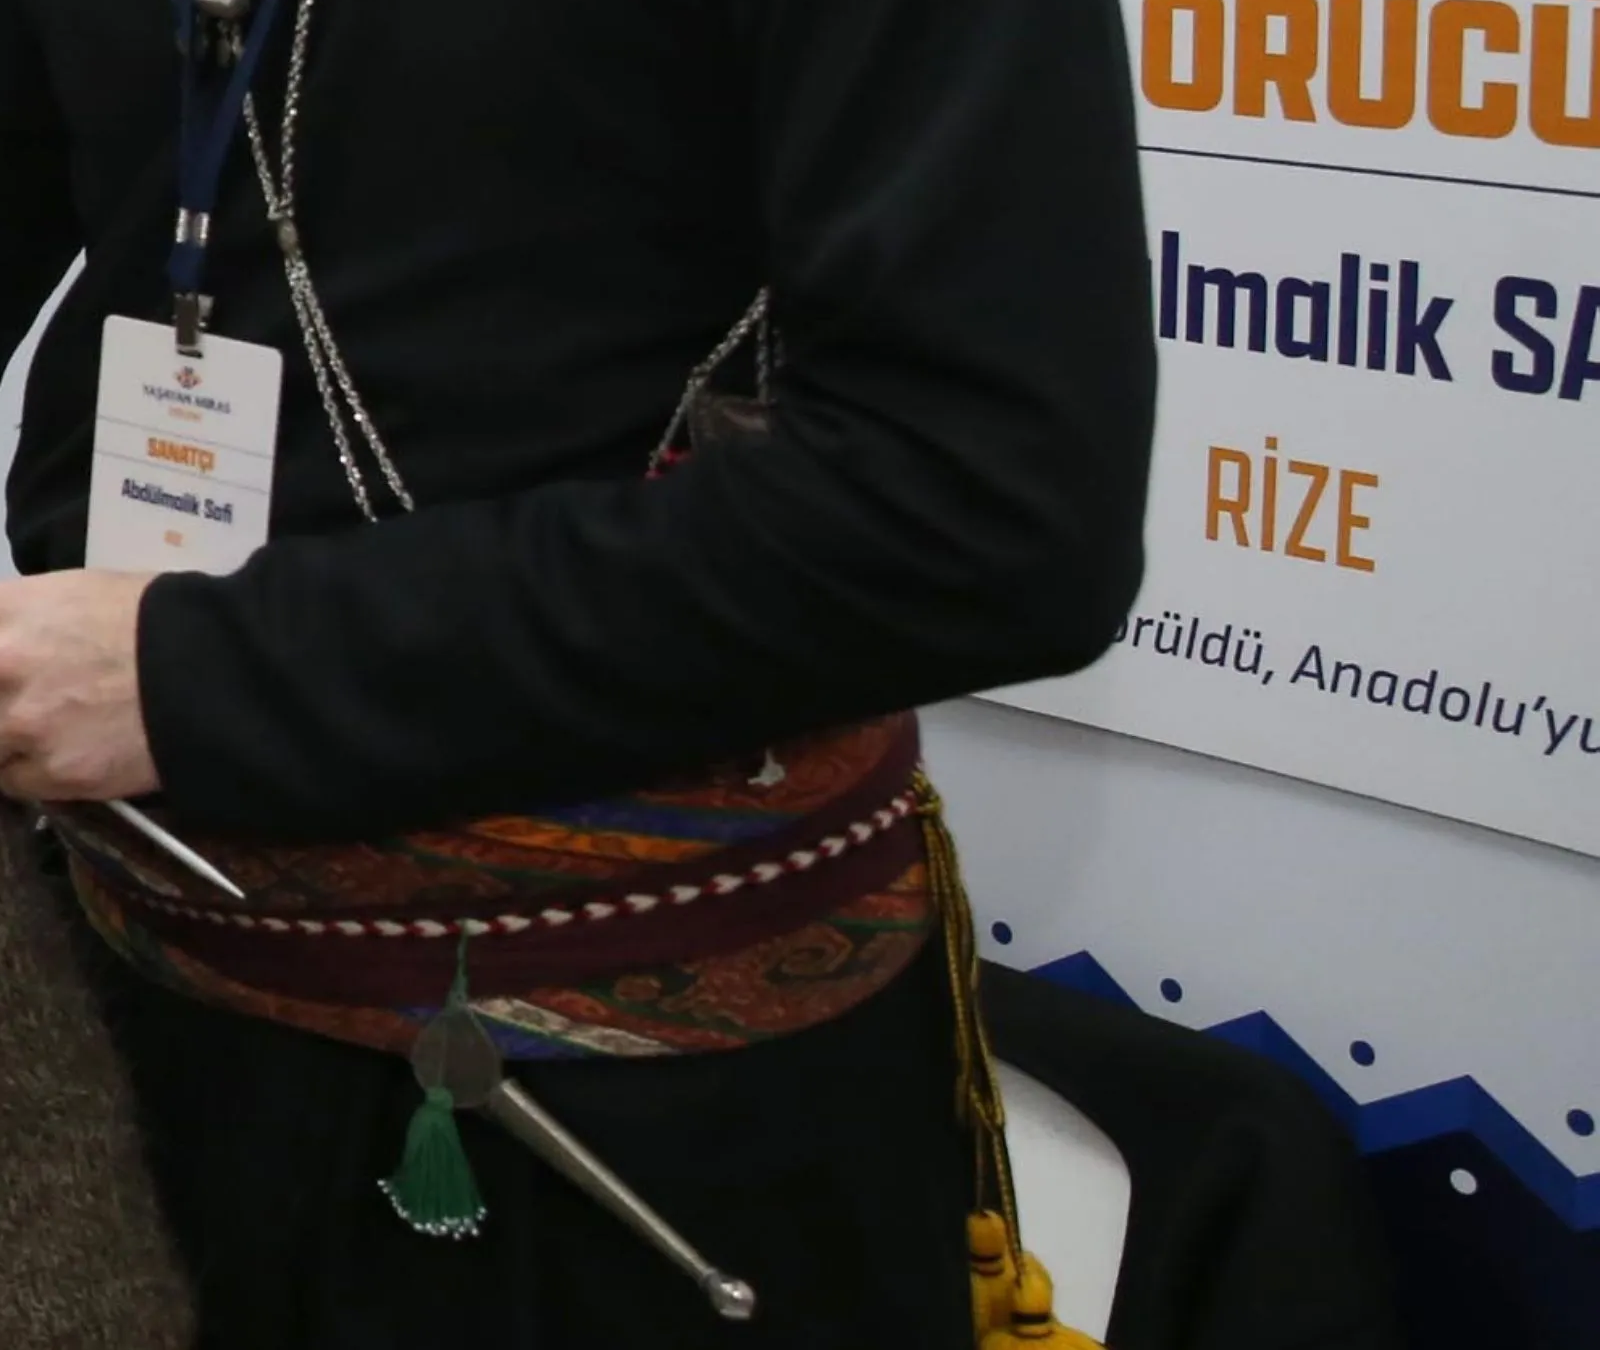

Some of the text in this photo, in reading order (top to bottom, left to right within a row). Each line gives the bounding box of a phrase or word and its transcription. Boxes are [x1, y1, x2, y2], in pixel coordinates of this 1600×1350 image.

[147, 436, 215, 473] SANATÇI
[121, 478, 233, 524] Abdülmalik Safi
[1206, 436, 1378, 573] RİZE
